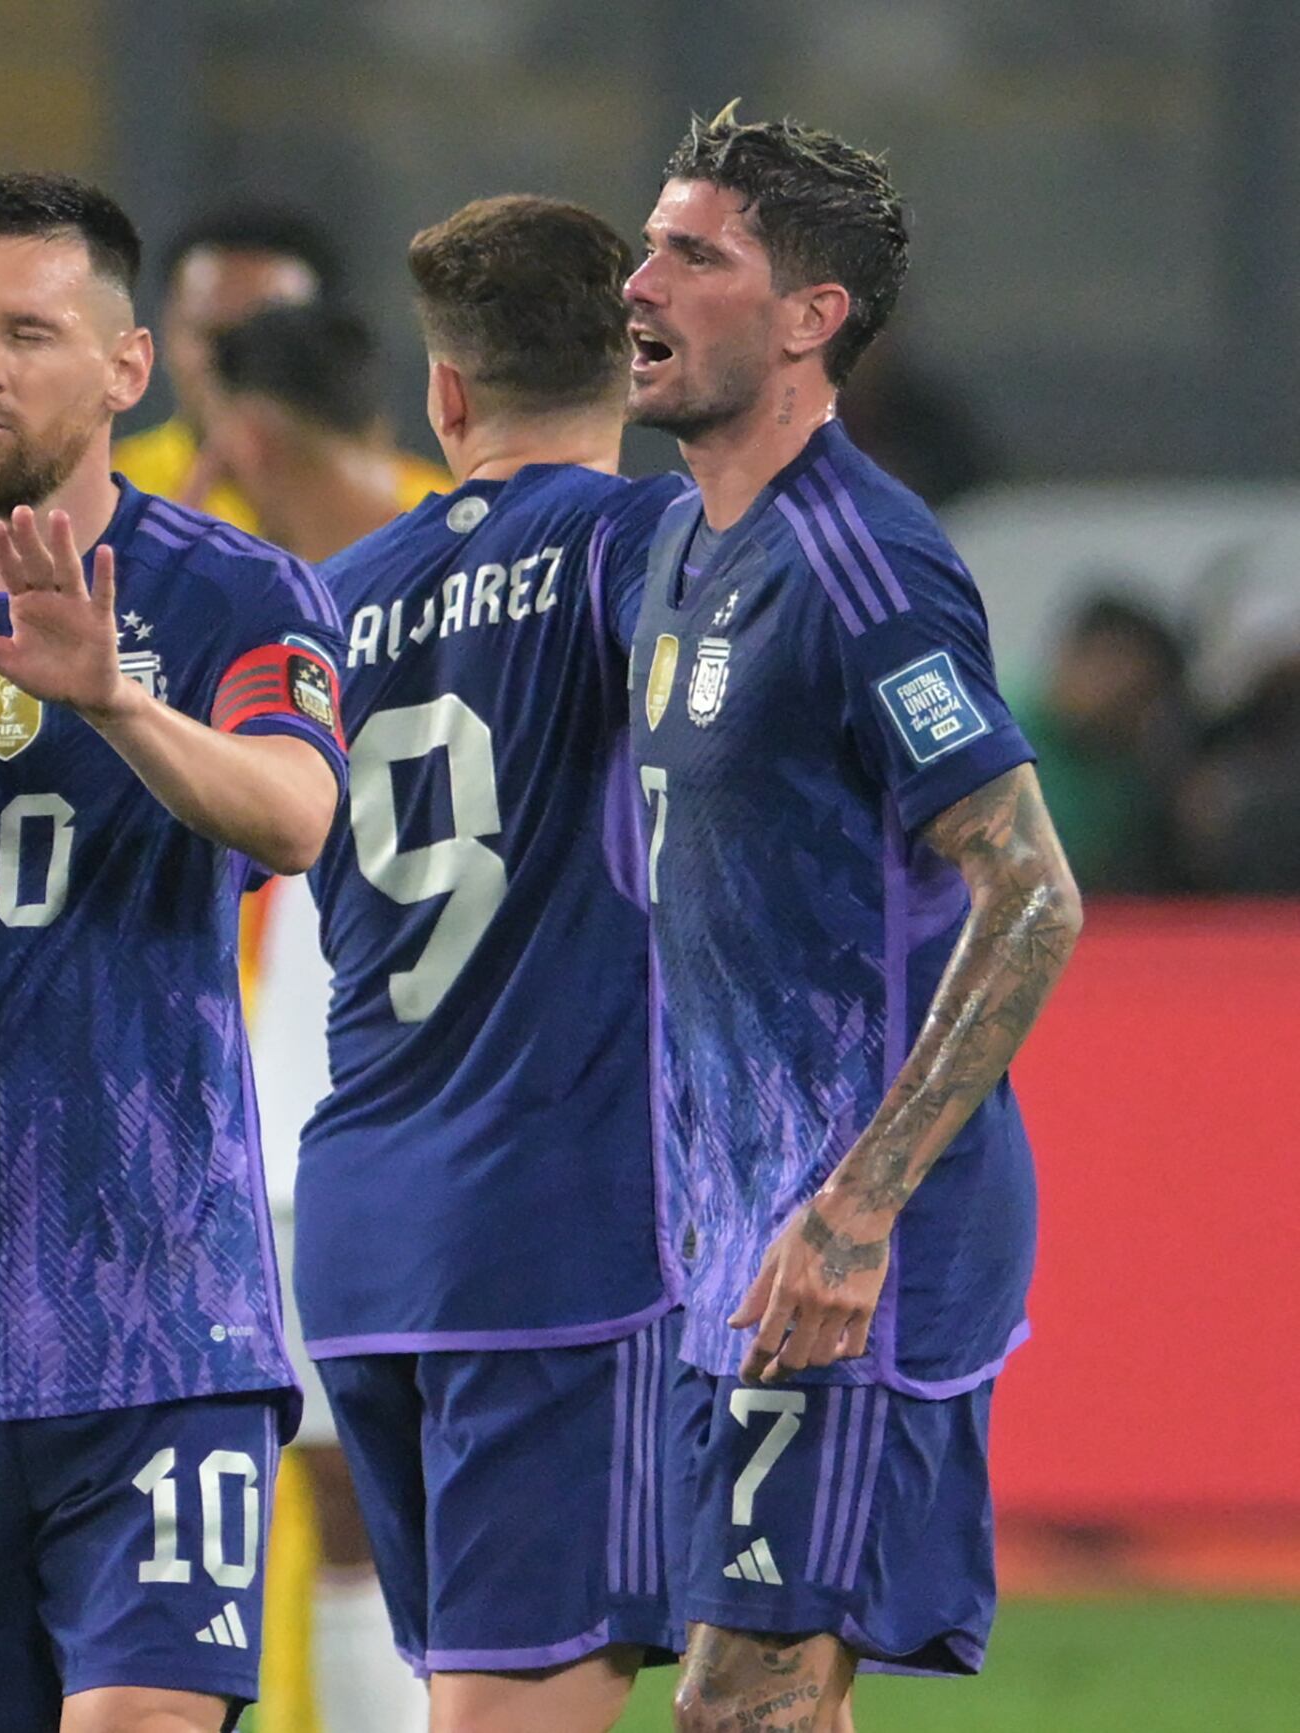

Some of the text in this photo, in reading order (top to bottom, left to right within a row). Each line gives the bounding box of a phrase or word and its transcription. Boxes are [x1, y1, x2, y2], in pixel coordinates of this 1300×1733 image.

[897, 669, 943, 700] FOOTBALL
[903, 681, 952, 716] UNITES
[909, 696, 963, 733] the World
[934, 720, 957, 737] FIFA
[348, 693, 508, 1023] 9
[640, 765, 668, 904] 7
[729, 1388, 806, 1526] 7
[132, 1447, 259, 1589] 10
